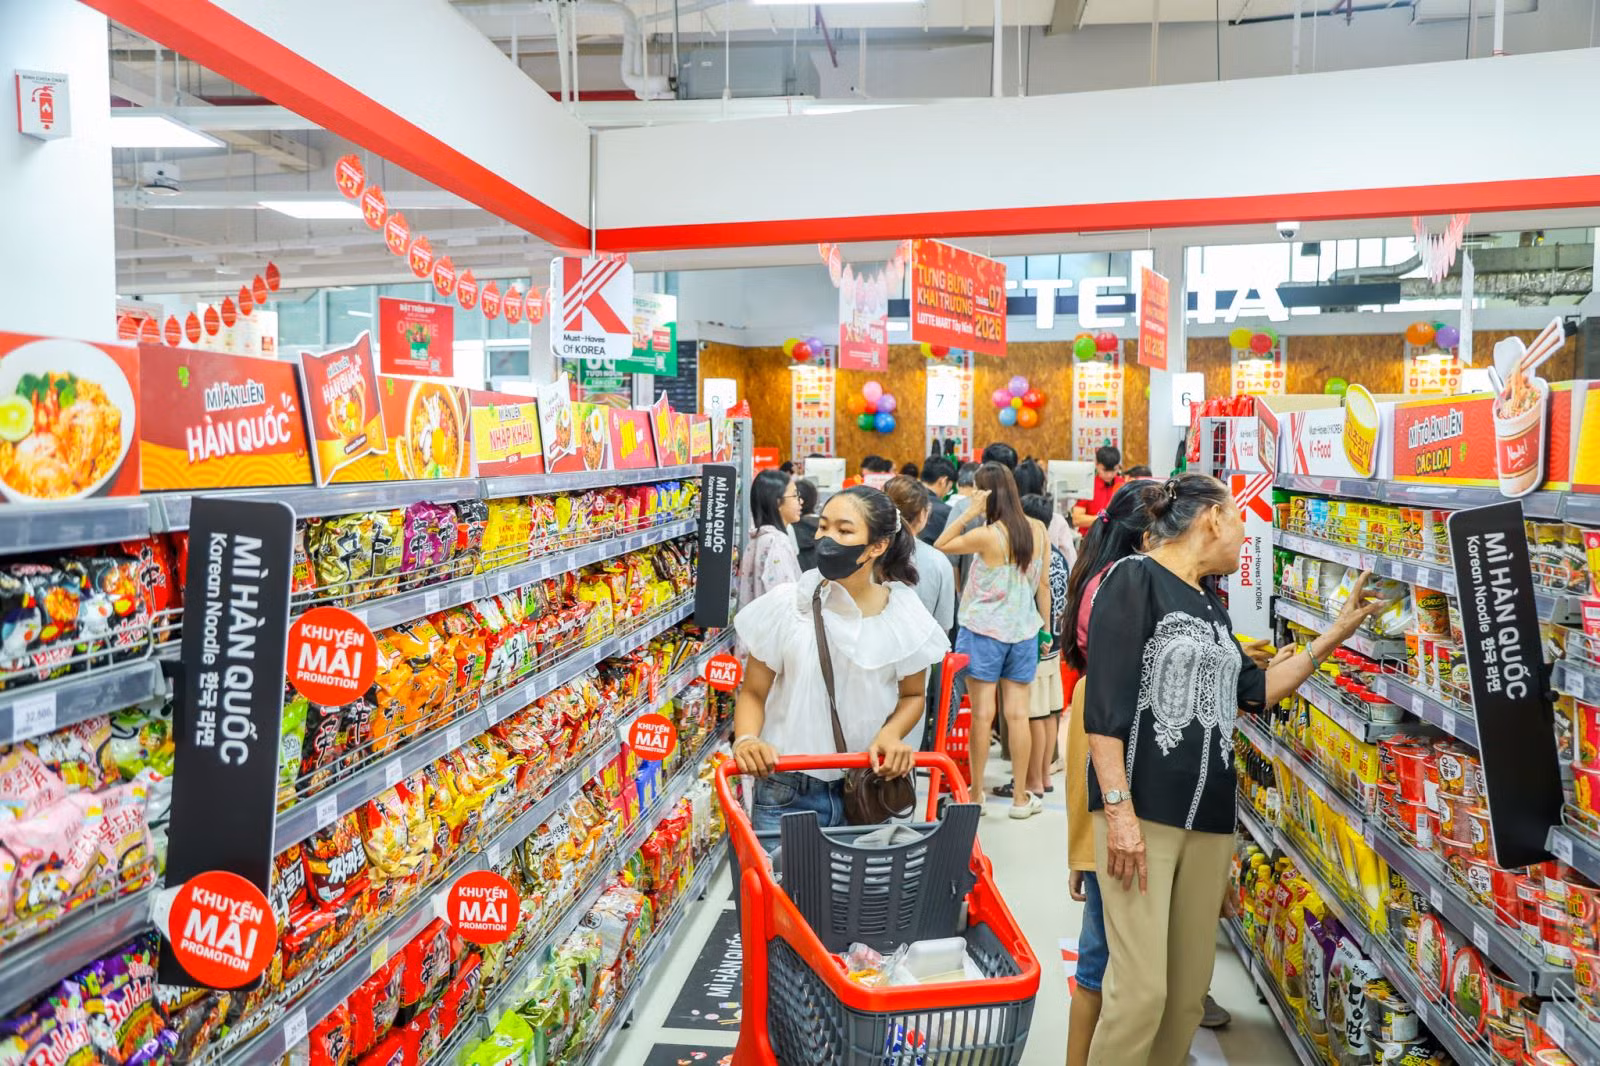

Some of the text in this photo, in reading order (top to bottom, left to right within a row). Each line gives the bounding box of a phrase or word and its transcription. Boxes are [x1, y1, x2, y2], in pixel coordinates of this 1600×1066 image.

[917, 287, 938, 307] KHAI
[988, 284, 1002, 309] 07
[917, 312, 936, 326] LOTTE
[936, 315, 951, 331] MART
[975, 314, 1002, 340] 2026
[563, 344, 606, 355] Of KOREA
[206, 383, 222, 411] MÌ
[241, 379, 265, 405] LIỀN
[935, 394, 945, 408] 7
[1182, 392, 1192, 406] 6
[186, 416, 236, 463] HÀN
[237, 405, 291, 451] QUỐC
[490, 417, 532, 454] NHẬP KHẨU
[1309, 440, 1332, 459] K-Food
[1415, 447, 1452, 477] CÁC LOẠI
[713, 476, 729, 553] MÌ HÀN QUỐC
[1466, 535, 1502, 693] Korean Noodle 한국 라면
[1484, 532, 1531, 700] MÌ HÀN QUỐC
[195, 532, 228, 747] Korean Noodle 한국 라면
[301, 623, 364, 647] KHUYẾN
[220, 534, 269, 765] MÌ HÀN QUỐC
[298, 642, 363, 679] MÃI
[296, 671, 359, 690] PROMOTION
[710, 668, 736, 681] MÃI
[635, 731, 668, 749] MÃI
[458, 885, 508, 899] KHUYẾN
[192, 886, 264, 924] KHUYẾN
[459, 897, 507, 923] MÃI
[184, 908, 258, 960] MÃI
[458, 922, 507, 931] PROMOTION
[181, 938, 250, 973] PROMOTION
[710, 961, 743, 983] HÀN
[704, 983, 734, 998] MÌ
